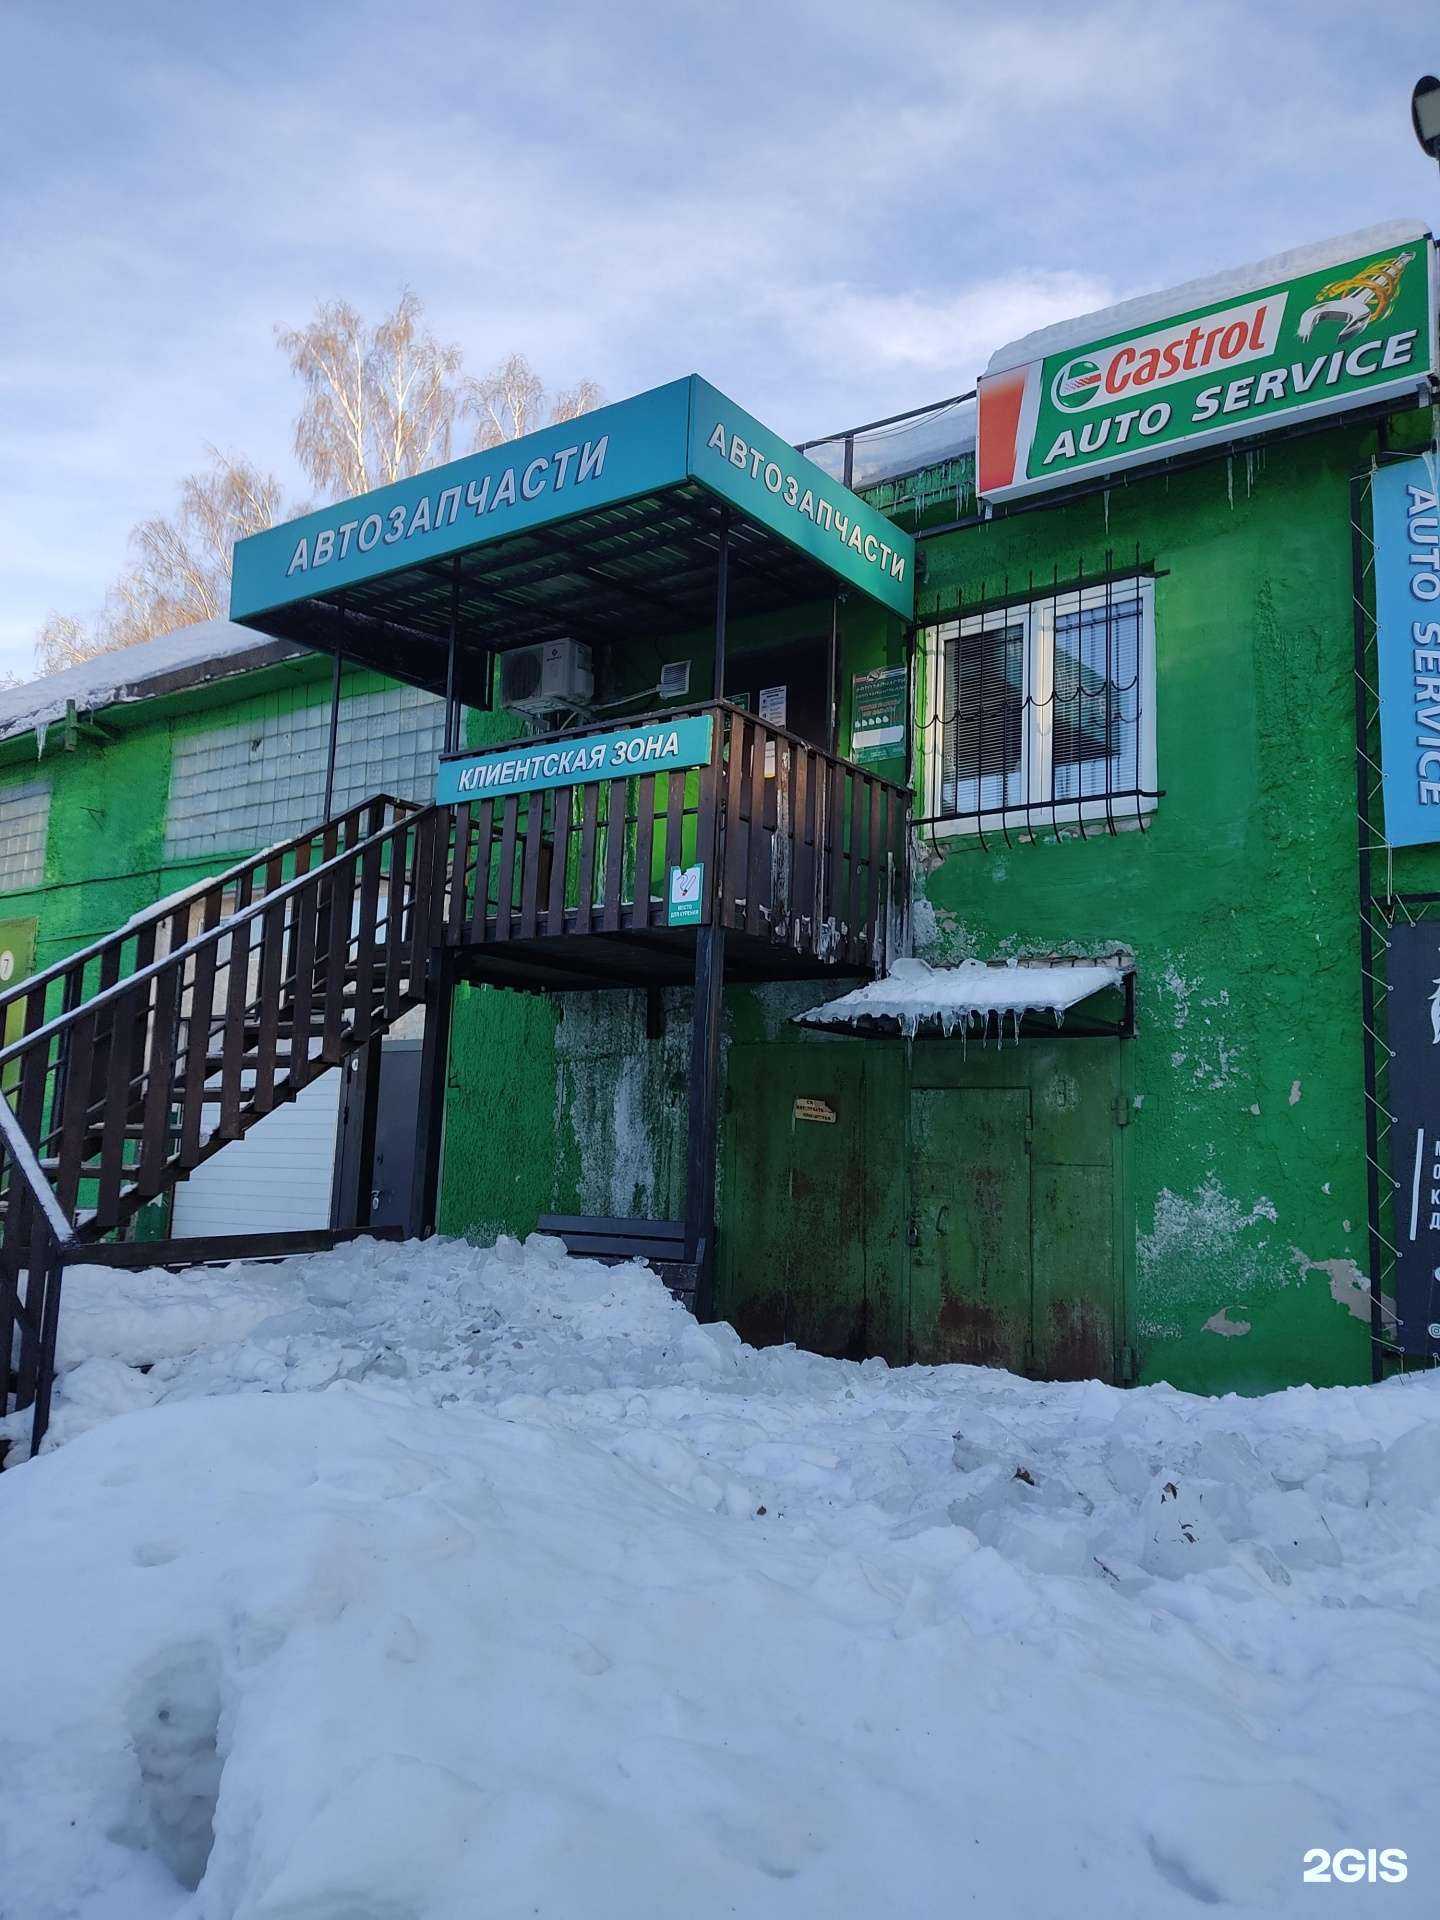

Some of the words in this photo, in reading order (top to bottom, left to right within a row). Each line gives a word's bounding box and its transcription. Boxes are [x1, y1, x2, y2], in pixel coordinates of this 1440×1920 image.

[1042, 402, 1173, 466] AUTO
[1191, 329, 1420, 423] SERVICE
[1105, 306, 1268, 394] Castrol
[285, 436, 611, 578] АВТОЗАПЧАСТИ
[707, 422, 906, 583] АВТОЗАПЧАСТИ
[1407, 484, 1440, 602] AUTO
[457, 744, 606, 792] КЛИЕНТСКАЯ
[609, 731, 680, 766] ЗОНА
